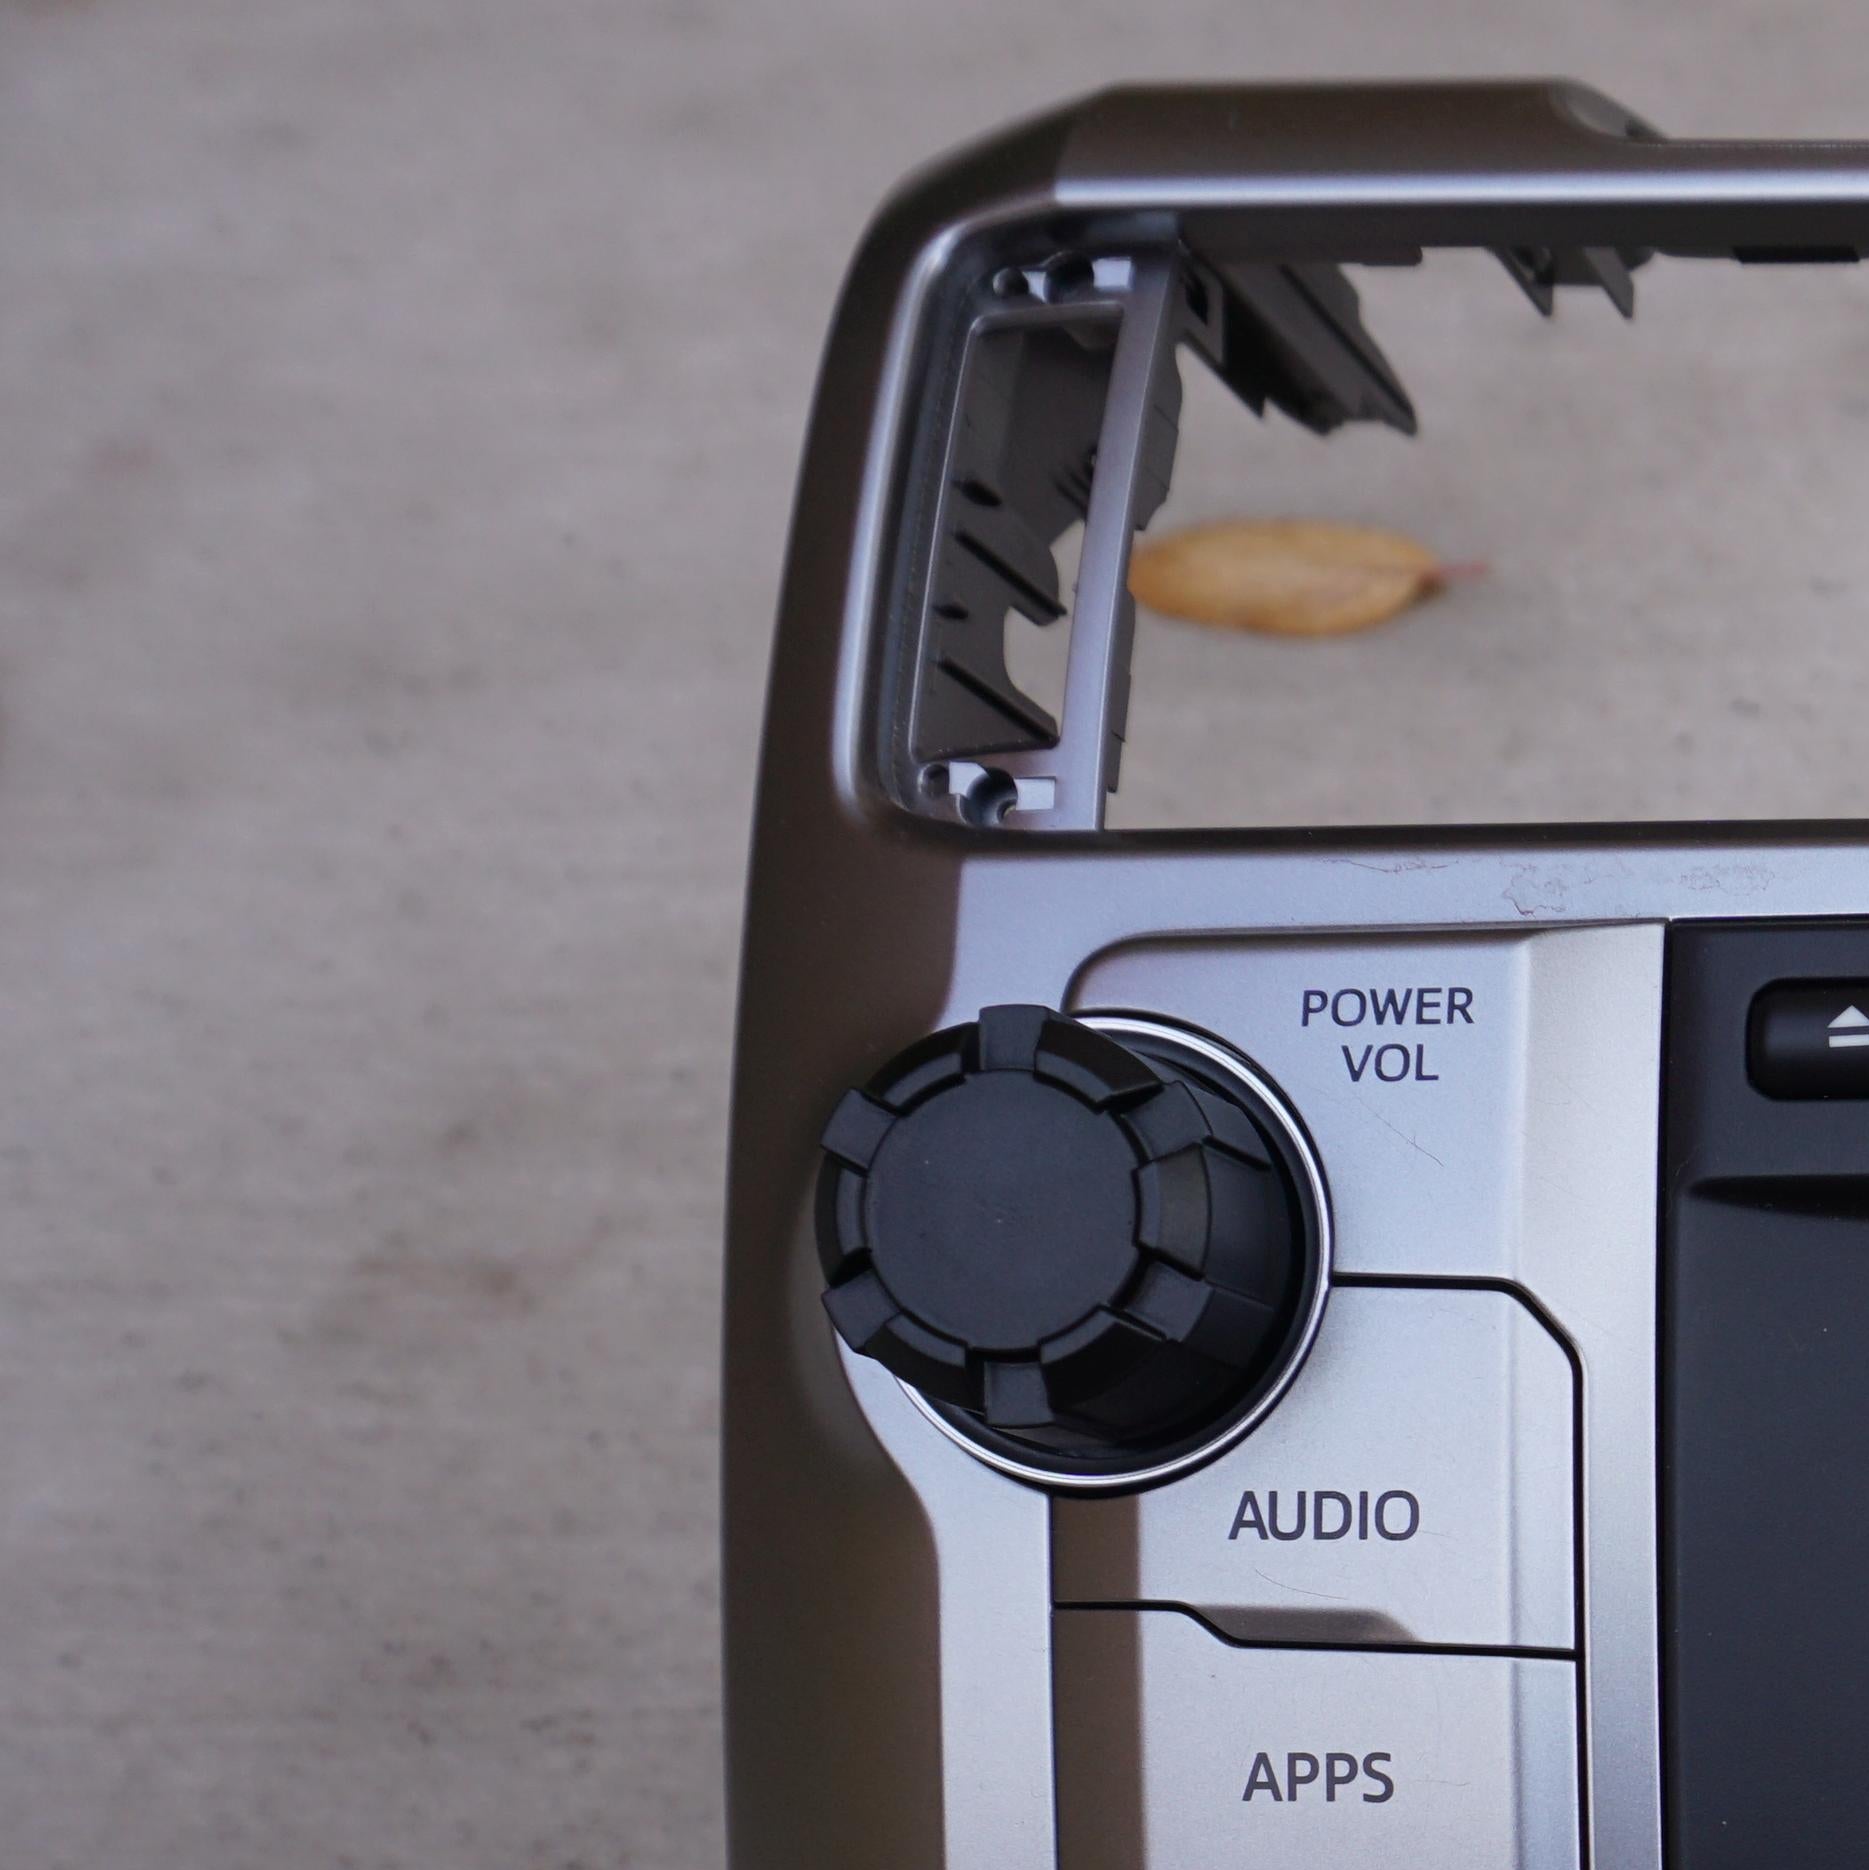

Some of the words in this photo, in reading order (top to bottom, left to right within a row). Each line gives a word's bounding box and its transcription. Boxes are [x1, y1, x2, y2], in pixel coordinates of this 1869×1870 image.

[1301, 986, 1475, 1027] POWER
[1341, 1043, 1439, 1082] VOL
[1227, 1490, 1420, 1541] AUDIO
[1241, 1751, 1396, 1804] APPS
